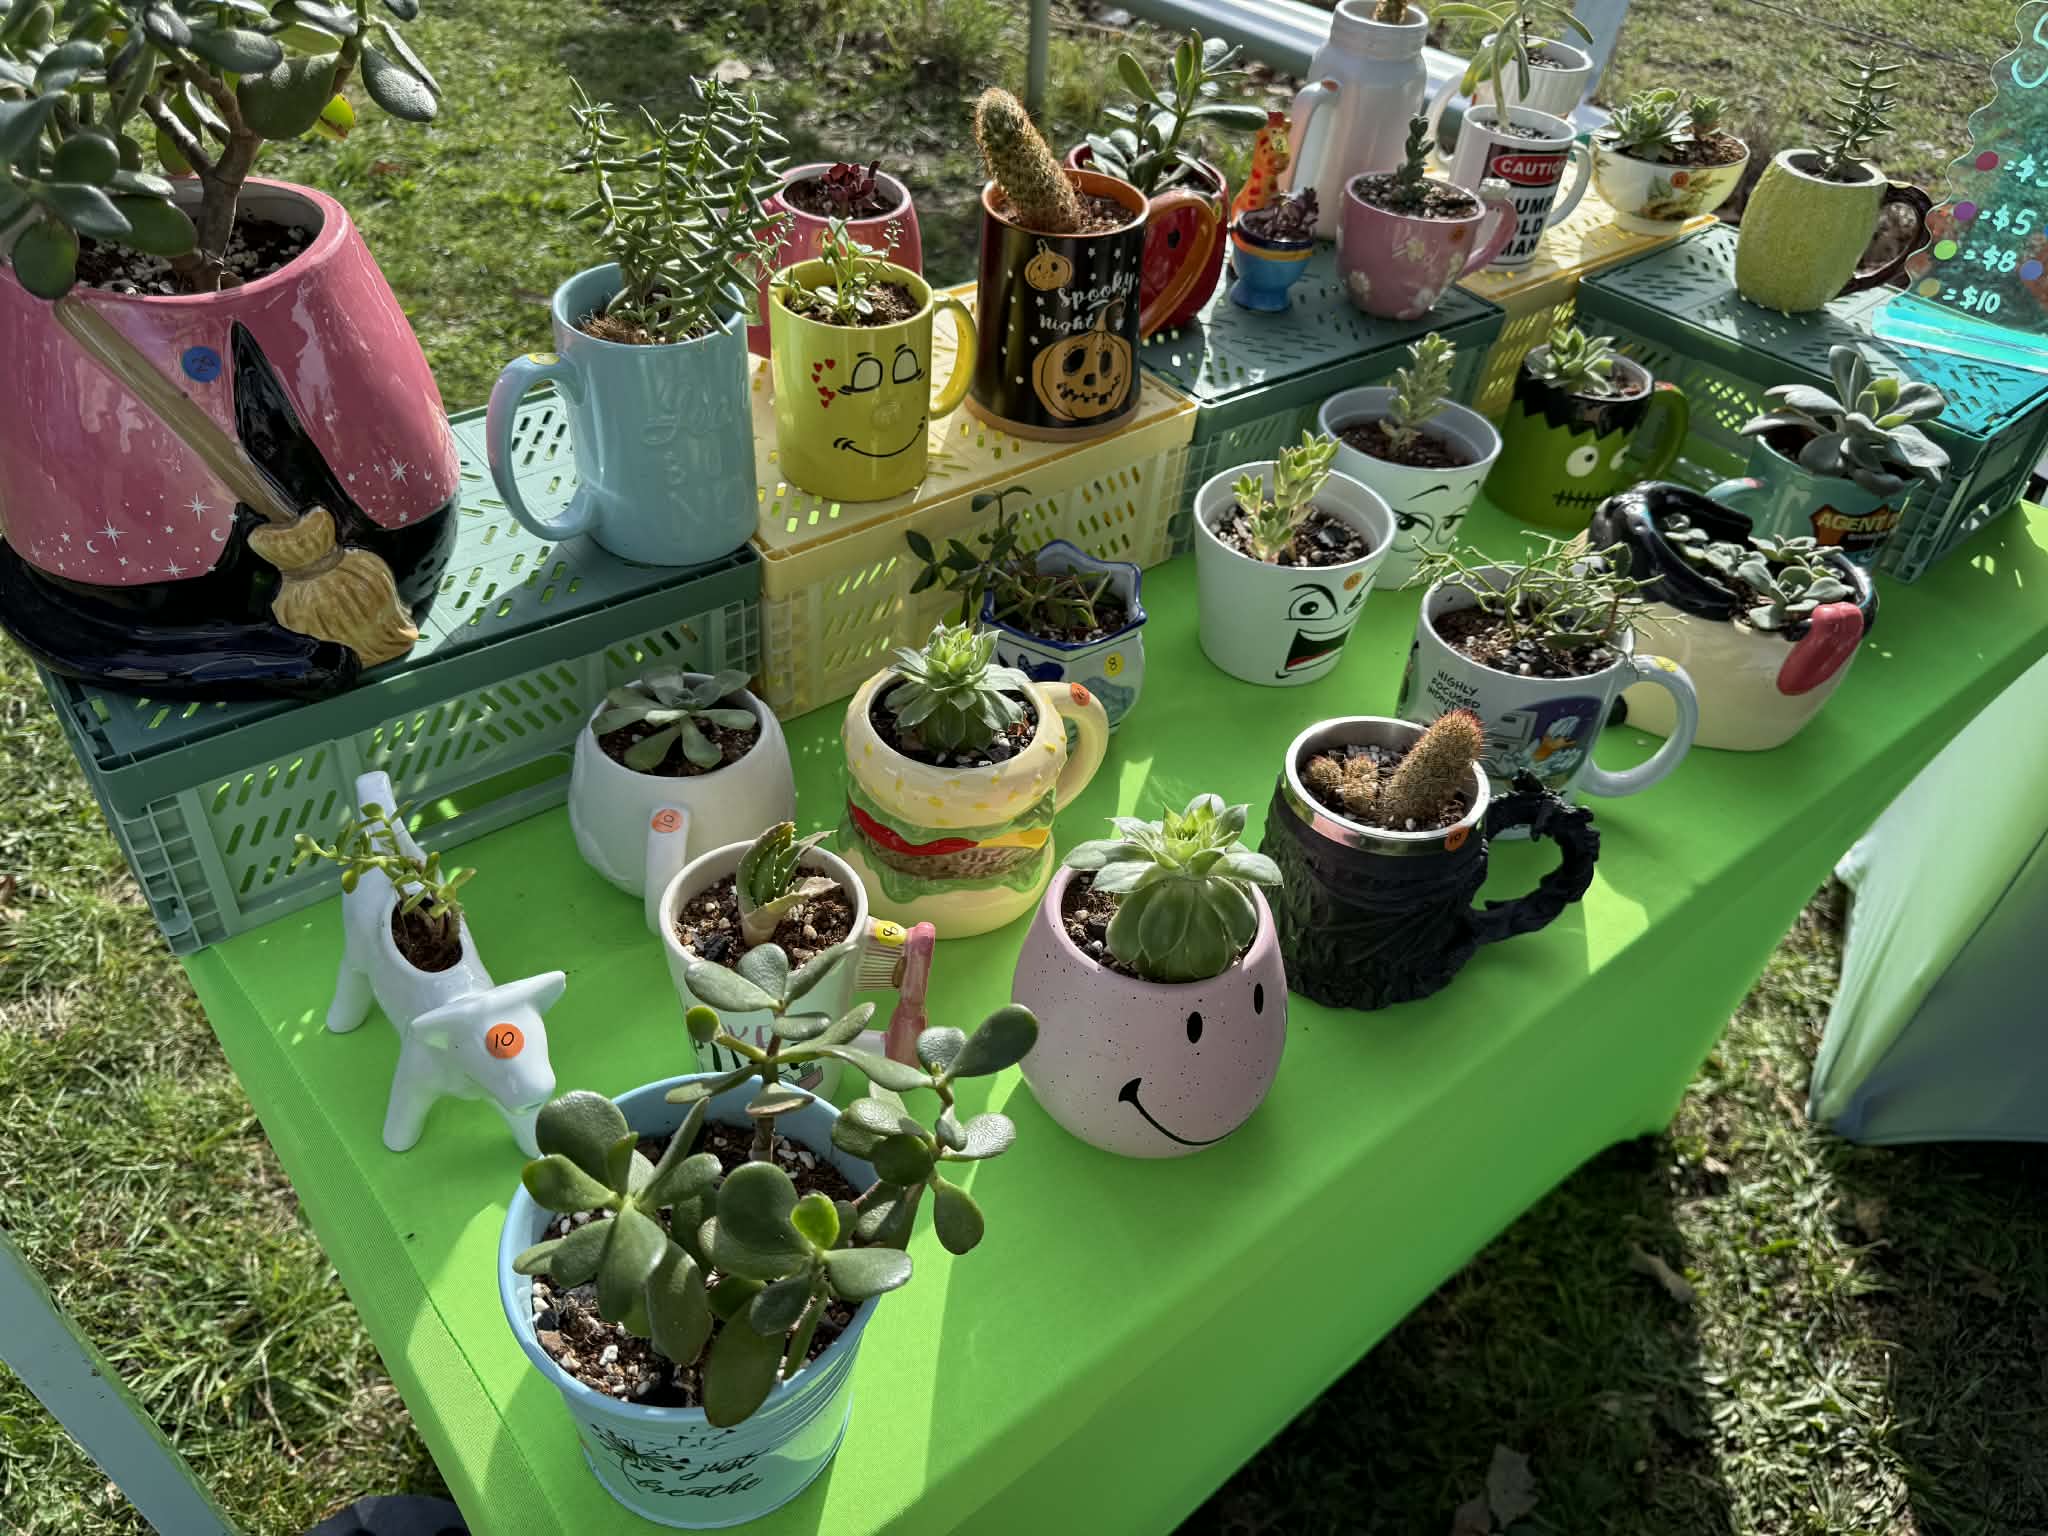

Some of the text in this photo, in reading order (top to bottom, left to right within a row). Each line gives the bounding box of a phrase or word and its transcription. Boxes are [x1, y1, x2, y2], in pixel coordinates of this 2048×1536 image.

[1501, 159, 1567, 176] CAUTIO
[1515, 218, 1543, 235] LD
[1959, 285, 2001, 314] $10
[1816, 510, 1887, 532] AGENT
[1107, 656, 1119, 671] 8
[1431, 677, 1481, 709] FOCUSED
[1438, 669, 1480, 697] HIGHLY
[495, 1031, 515, 1049] 10
